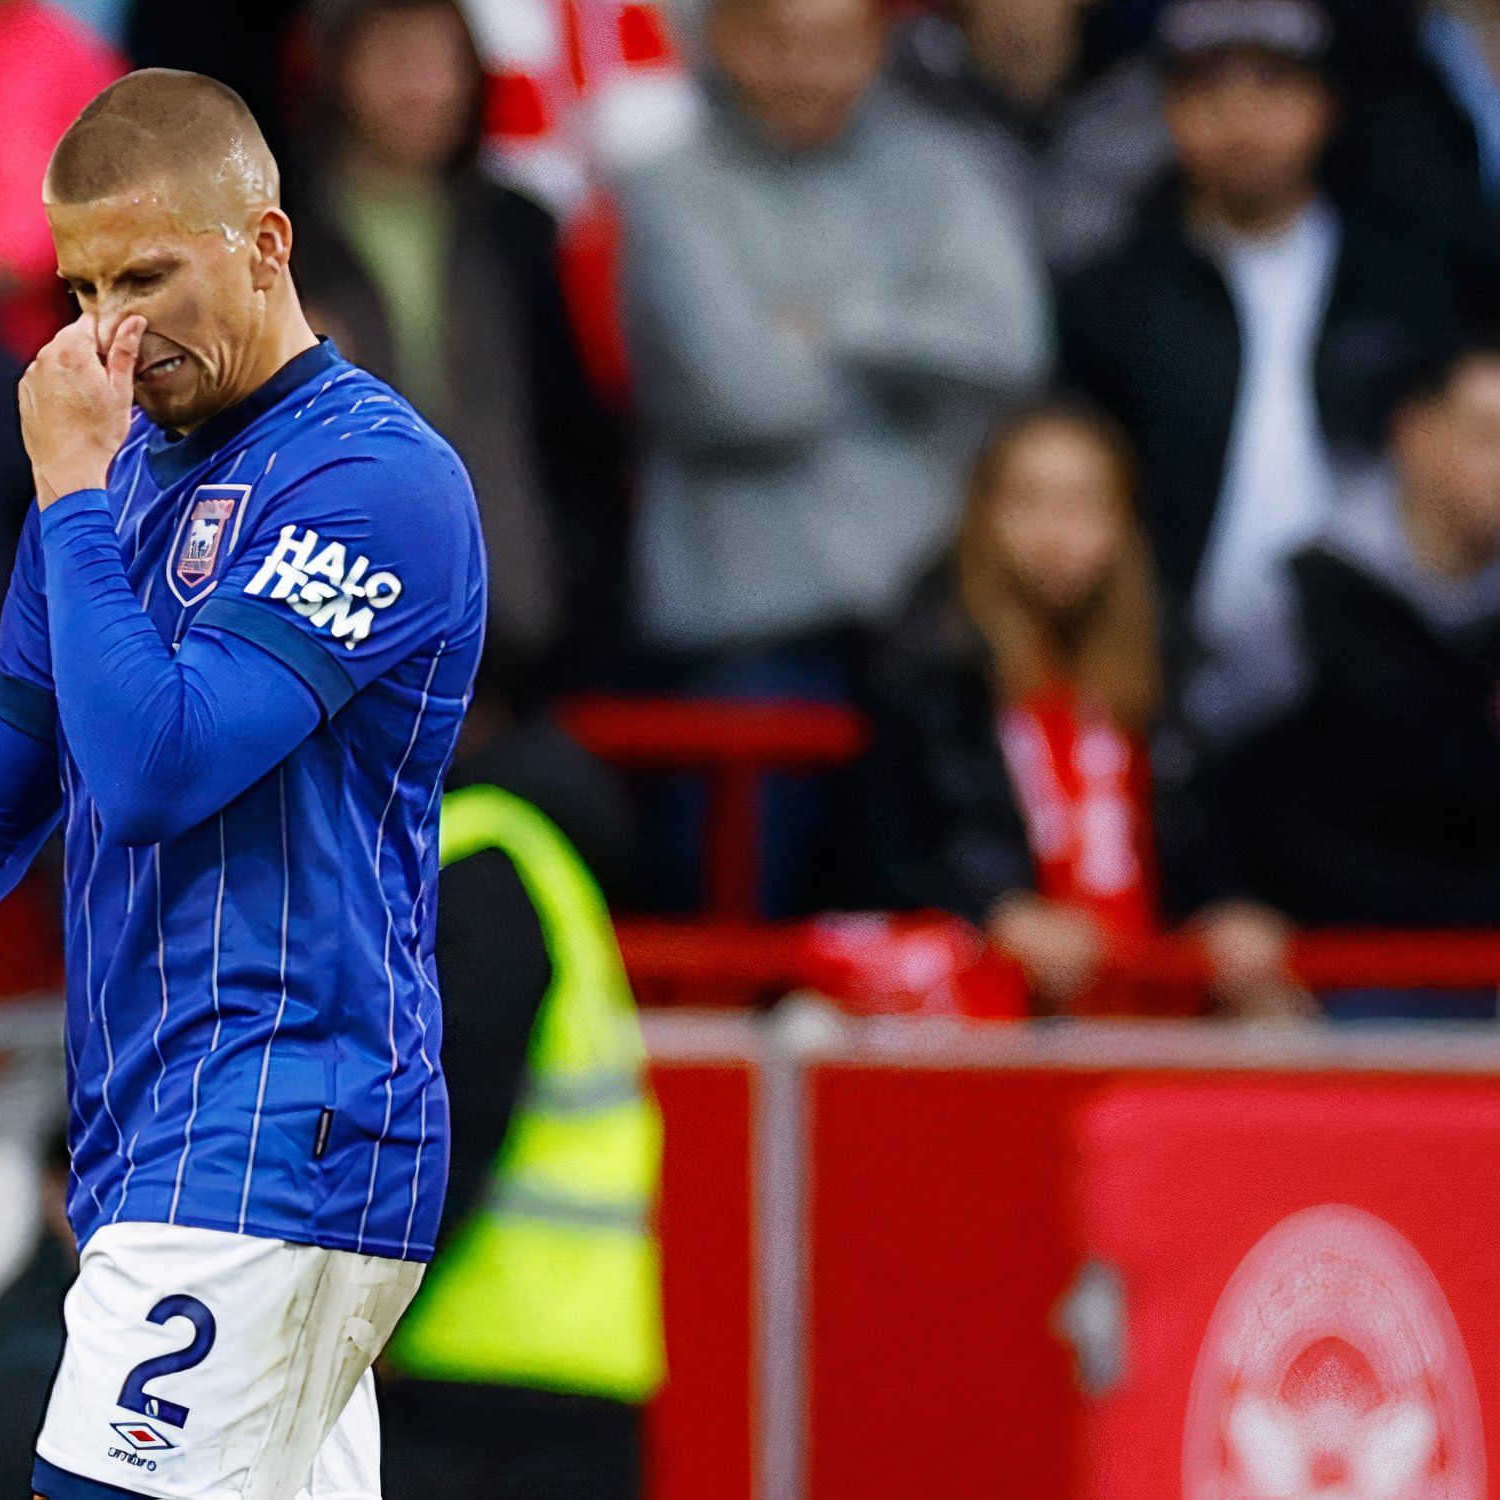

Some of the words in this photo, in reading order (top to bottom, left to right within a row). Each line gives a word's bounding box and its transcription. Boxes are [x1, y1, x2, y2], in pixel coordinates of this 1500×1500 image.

[243, 556, 375, 650] ITSM
[271, 525, 402, 608] HALO
[116, 1293, 216, 1429] 2
